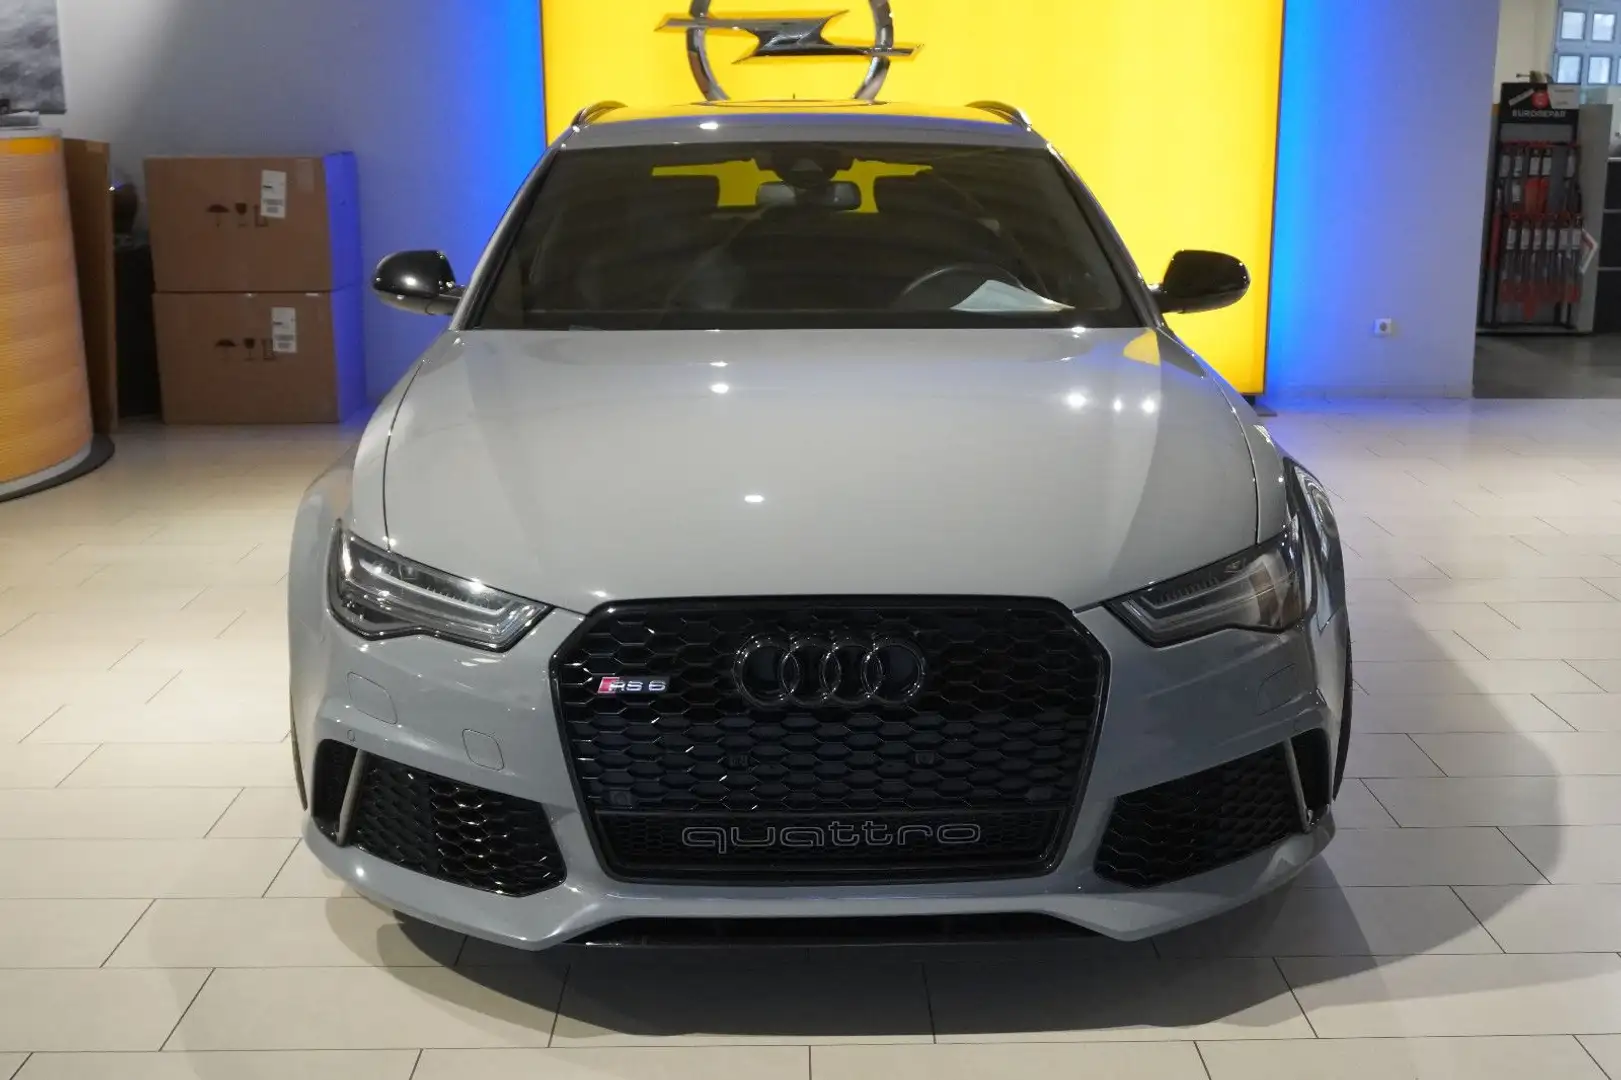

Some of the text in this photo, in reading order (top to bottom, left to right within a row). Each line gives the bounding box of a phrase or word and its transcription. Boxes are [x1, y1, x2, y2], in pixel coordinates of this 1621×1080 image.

[607, 680, 667, 692] RS 6
[681, 820, 981, 854] quattro
